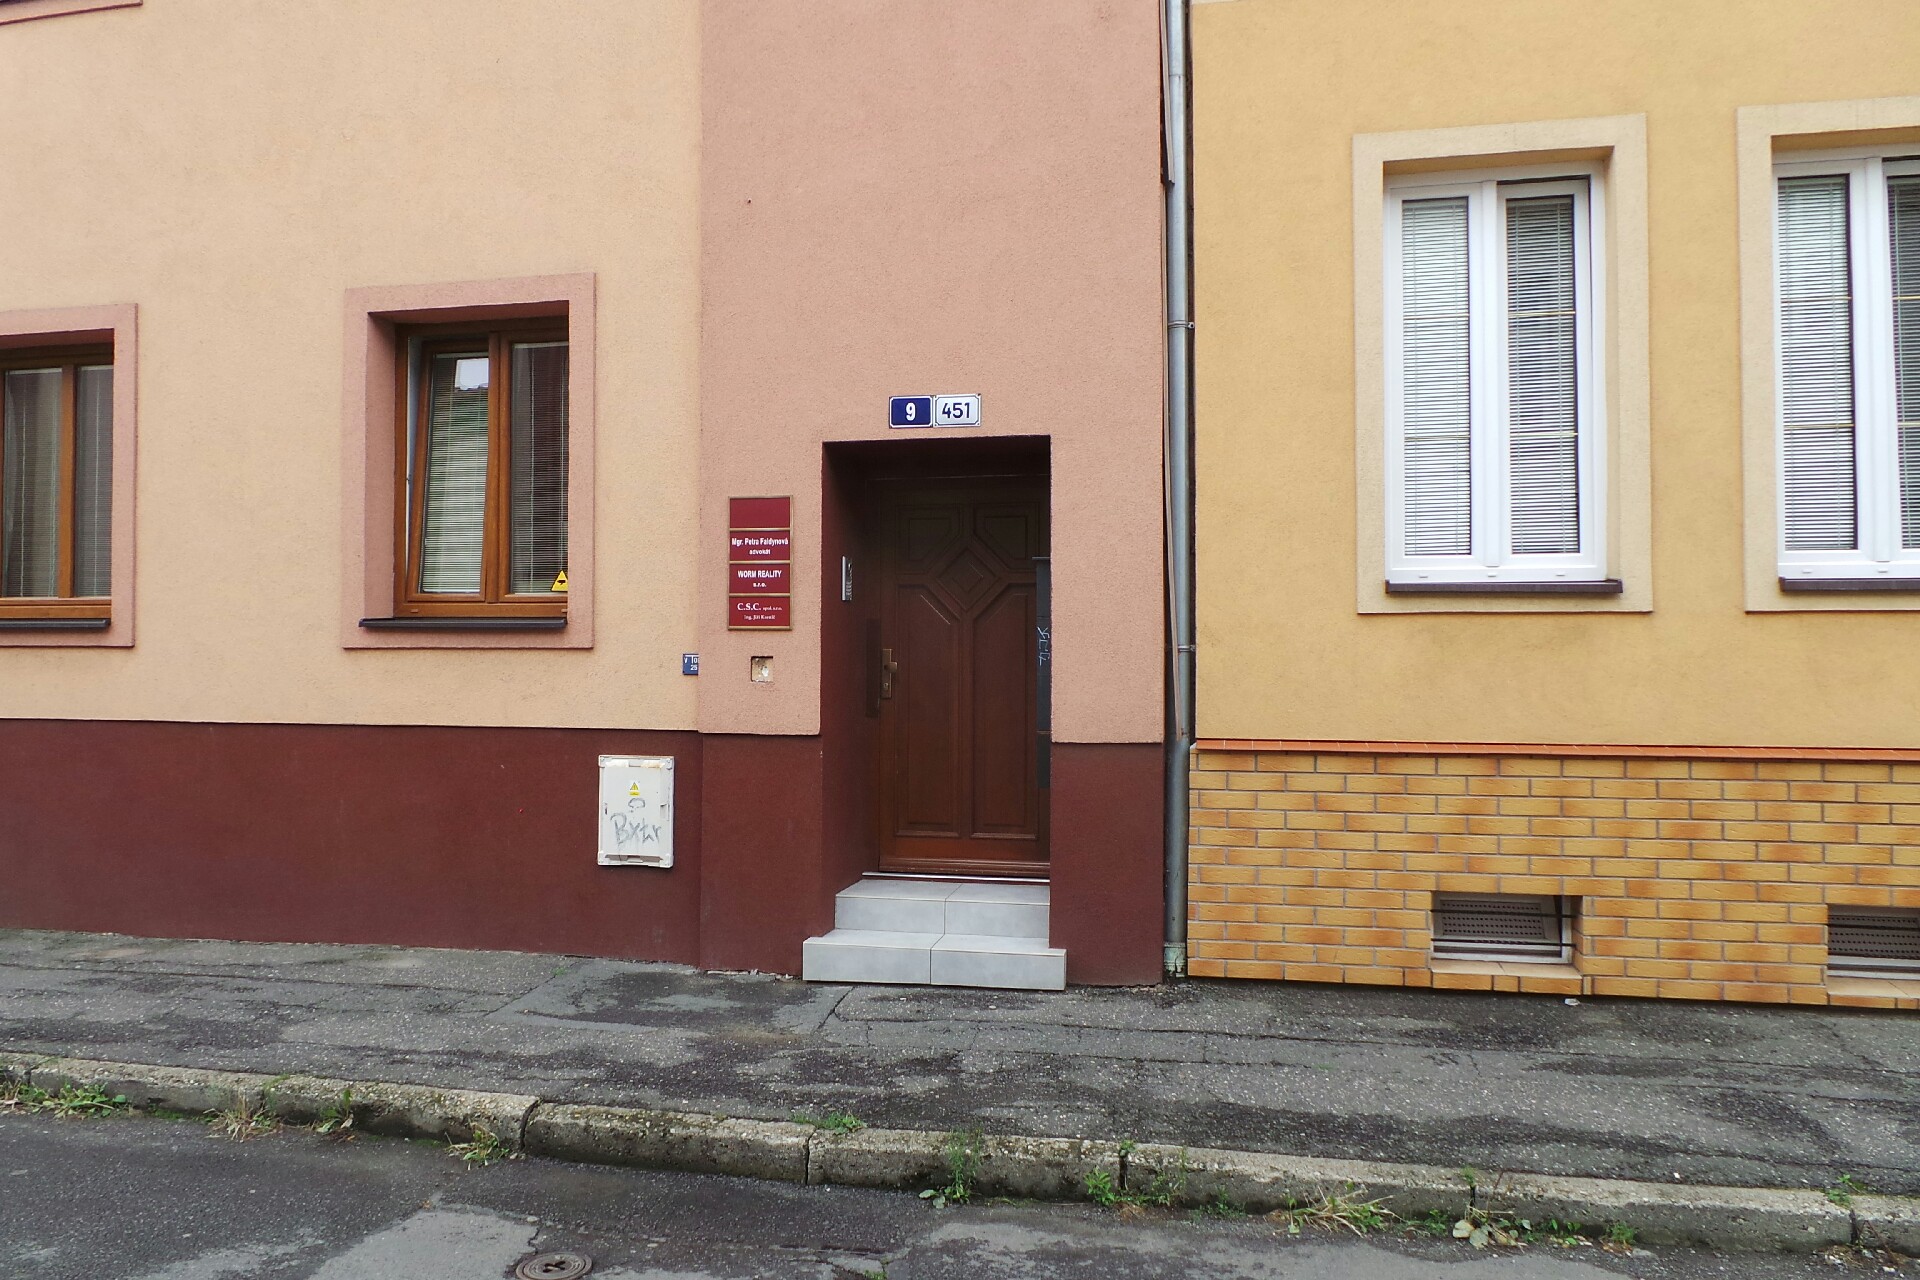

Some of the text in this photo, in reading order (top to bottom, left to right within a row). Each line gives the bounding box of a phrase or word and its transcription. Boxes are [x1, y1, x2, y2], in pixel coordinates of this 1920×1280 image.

[905, 402, 916, 421] 9
[941, 402, 971, 419] 451
[731, 537, 743, 547] Mgr.
[745, 537, 760, 546] Petra
[737, 570, 782, 578] WORM REALITY
[737, 602, 761, 611] C.S.C.
